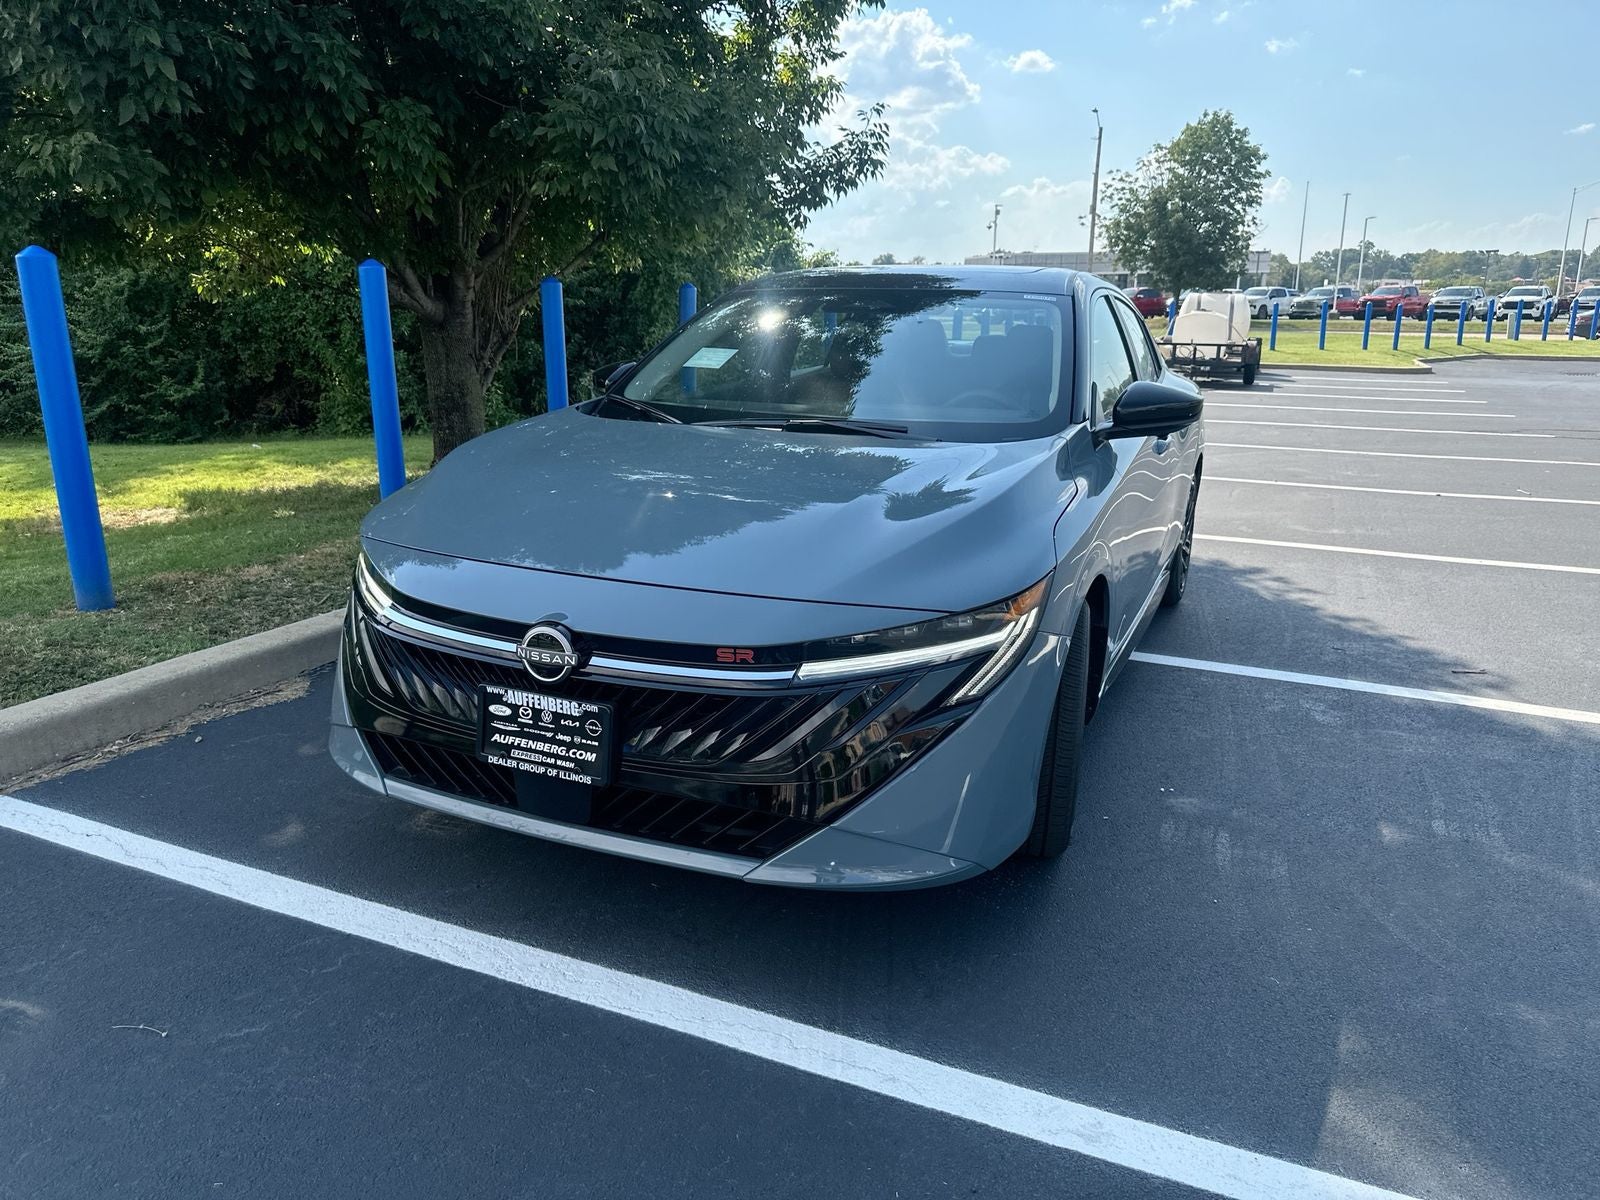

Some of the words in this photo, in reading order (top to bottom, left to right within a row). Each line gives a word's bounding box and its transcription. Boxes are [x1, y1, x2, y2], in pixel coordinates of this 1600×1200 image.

[517, 647, 576, 666] NISSAN
[715, 647, 755, 664] SR
[491, 733, 597, 762] AUFFENBERG.COM
[555, 733, 572, 743] Jeep
[512, 750, 541, 762] EXPRESS
[542, 756, 555, 765] CAR
[556, 759, 575, 769] WASH
[488, 755, 517, 769] DEALER
[518, 762, 545, 774] GROUP
[547, 768, 558, 777] OF
[559, 770, 592, 784] ILLINOIS
